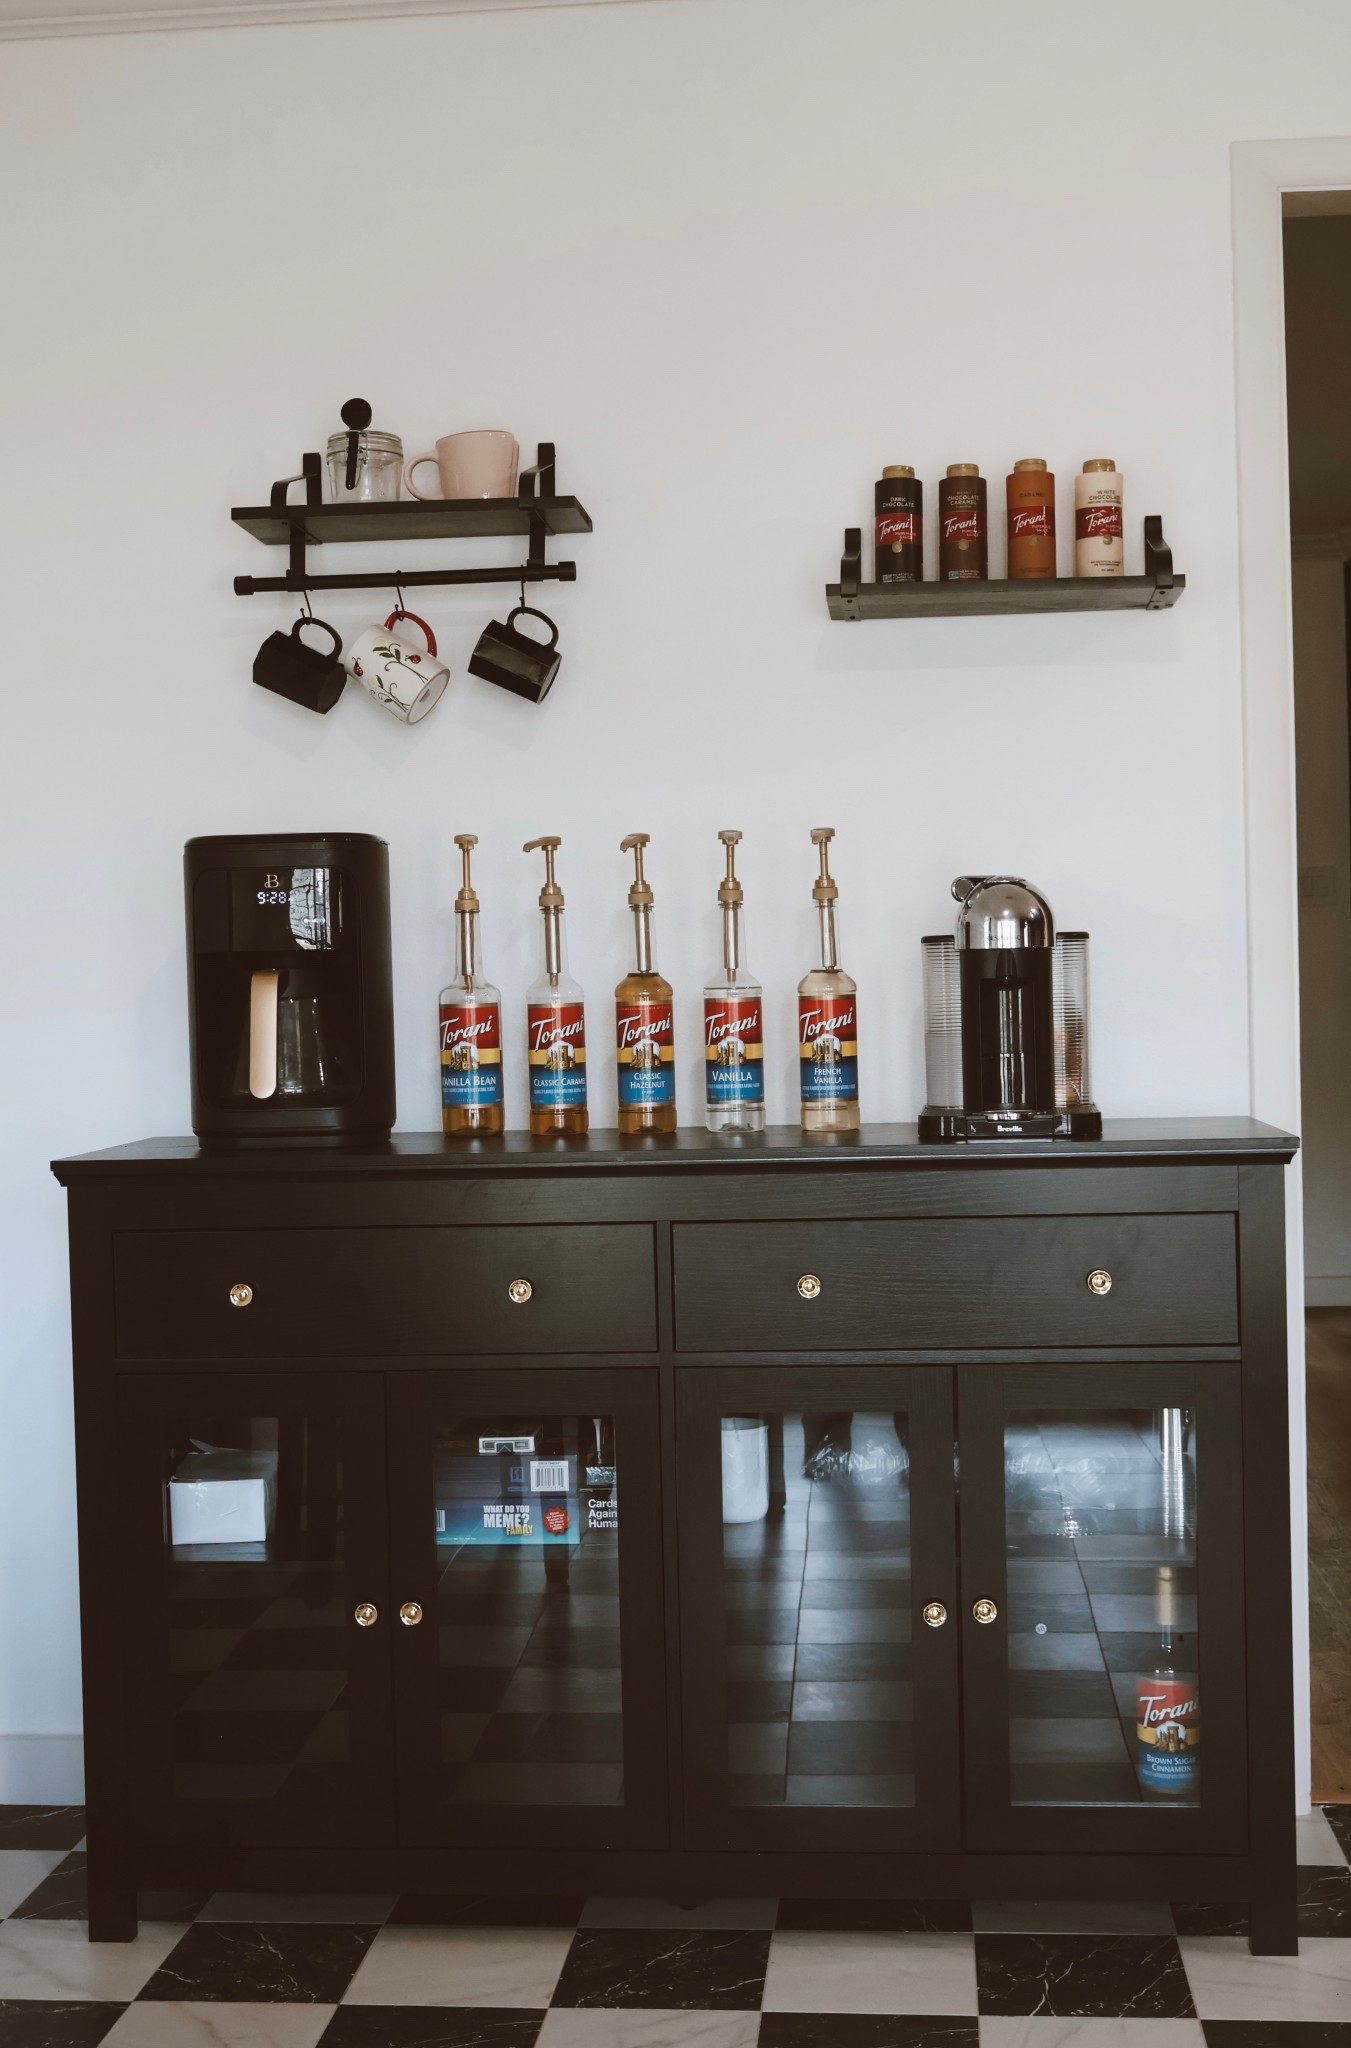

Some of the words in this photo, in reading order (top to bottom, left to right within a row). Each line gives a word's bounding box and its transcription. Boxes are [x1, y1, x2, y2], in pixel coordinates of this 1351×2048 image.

[944, 517, 977, 538] Torani
[1013, 512, 1046, 533] Torani
[1085, 511, 1119, 532] Torani
[879, 518, 911, 540] Torani
[264, 874, 280, 889] B
[257, 891, 287, 905] 9:28
[440, 1015, 493, 1051] Torani
[618, 1012, 671, 1049] Torani
[705, 1009, 758, 1047] Torani
[799, 1007, 853, 1045] Torani
[531, 1016, 584, 1052] Torani
[712, 1070, 753, 1081] VANILLA
[814, 1067, 842, 1075] FRENCH
[473, 1075, 497, 1086] BEAN
[534, 1078, 559, 1086] CLASSIC
[561, 1077, 586, 1086] CARAME
[630, 1081, 665, 1089] HAZELNUT
[813, 1076, 843, 1084] VANILLA
[483, 1504, 503, 1513] WHAT
[504, 1504, 515, 1513] DO
[515, 1504, 530, 1513] YOU
[588, 1498, 618, 1508] Cards
[483, 1513, 530, 1528] MEME?
[506, 1524, 533, 1536] FAMILY
[1146, 1753, 1172, 1764] BROWN
[1152, 1763, 1192, 1773] CINNAMON
